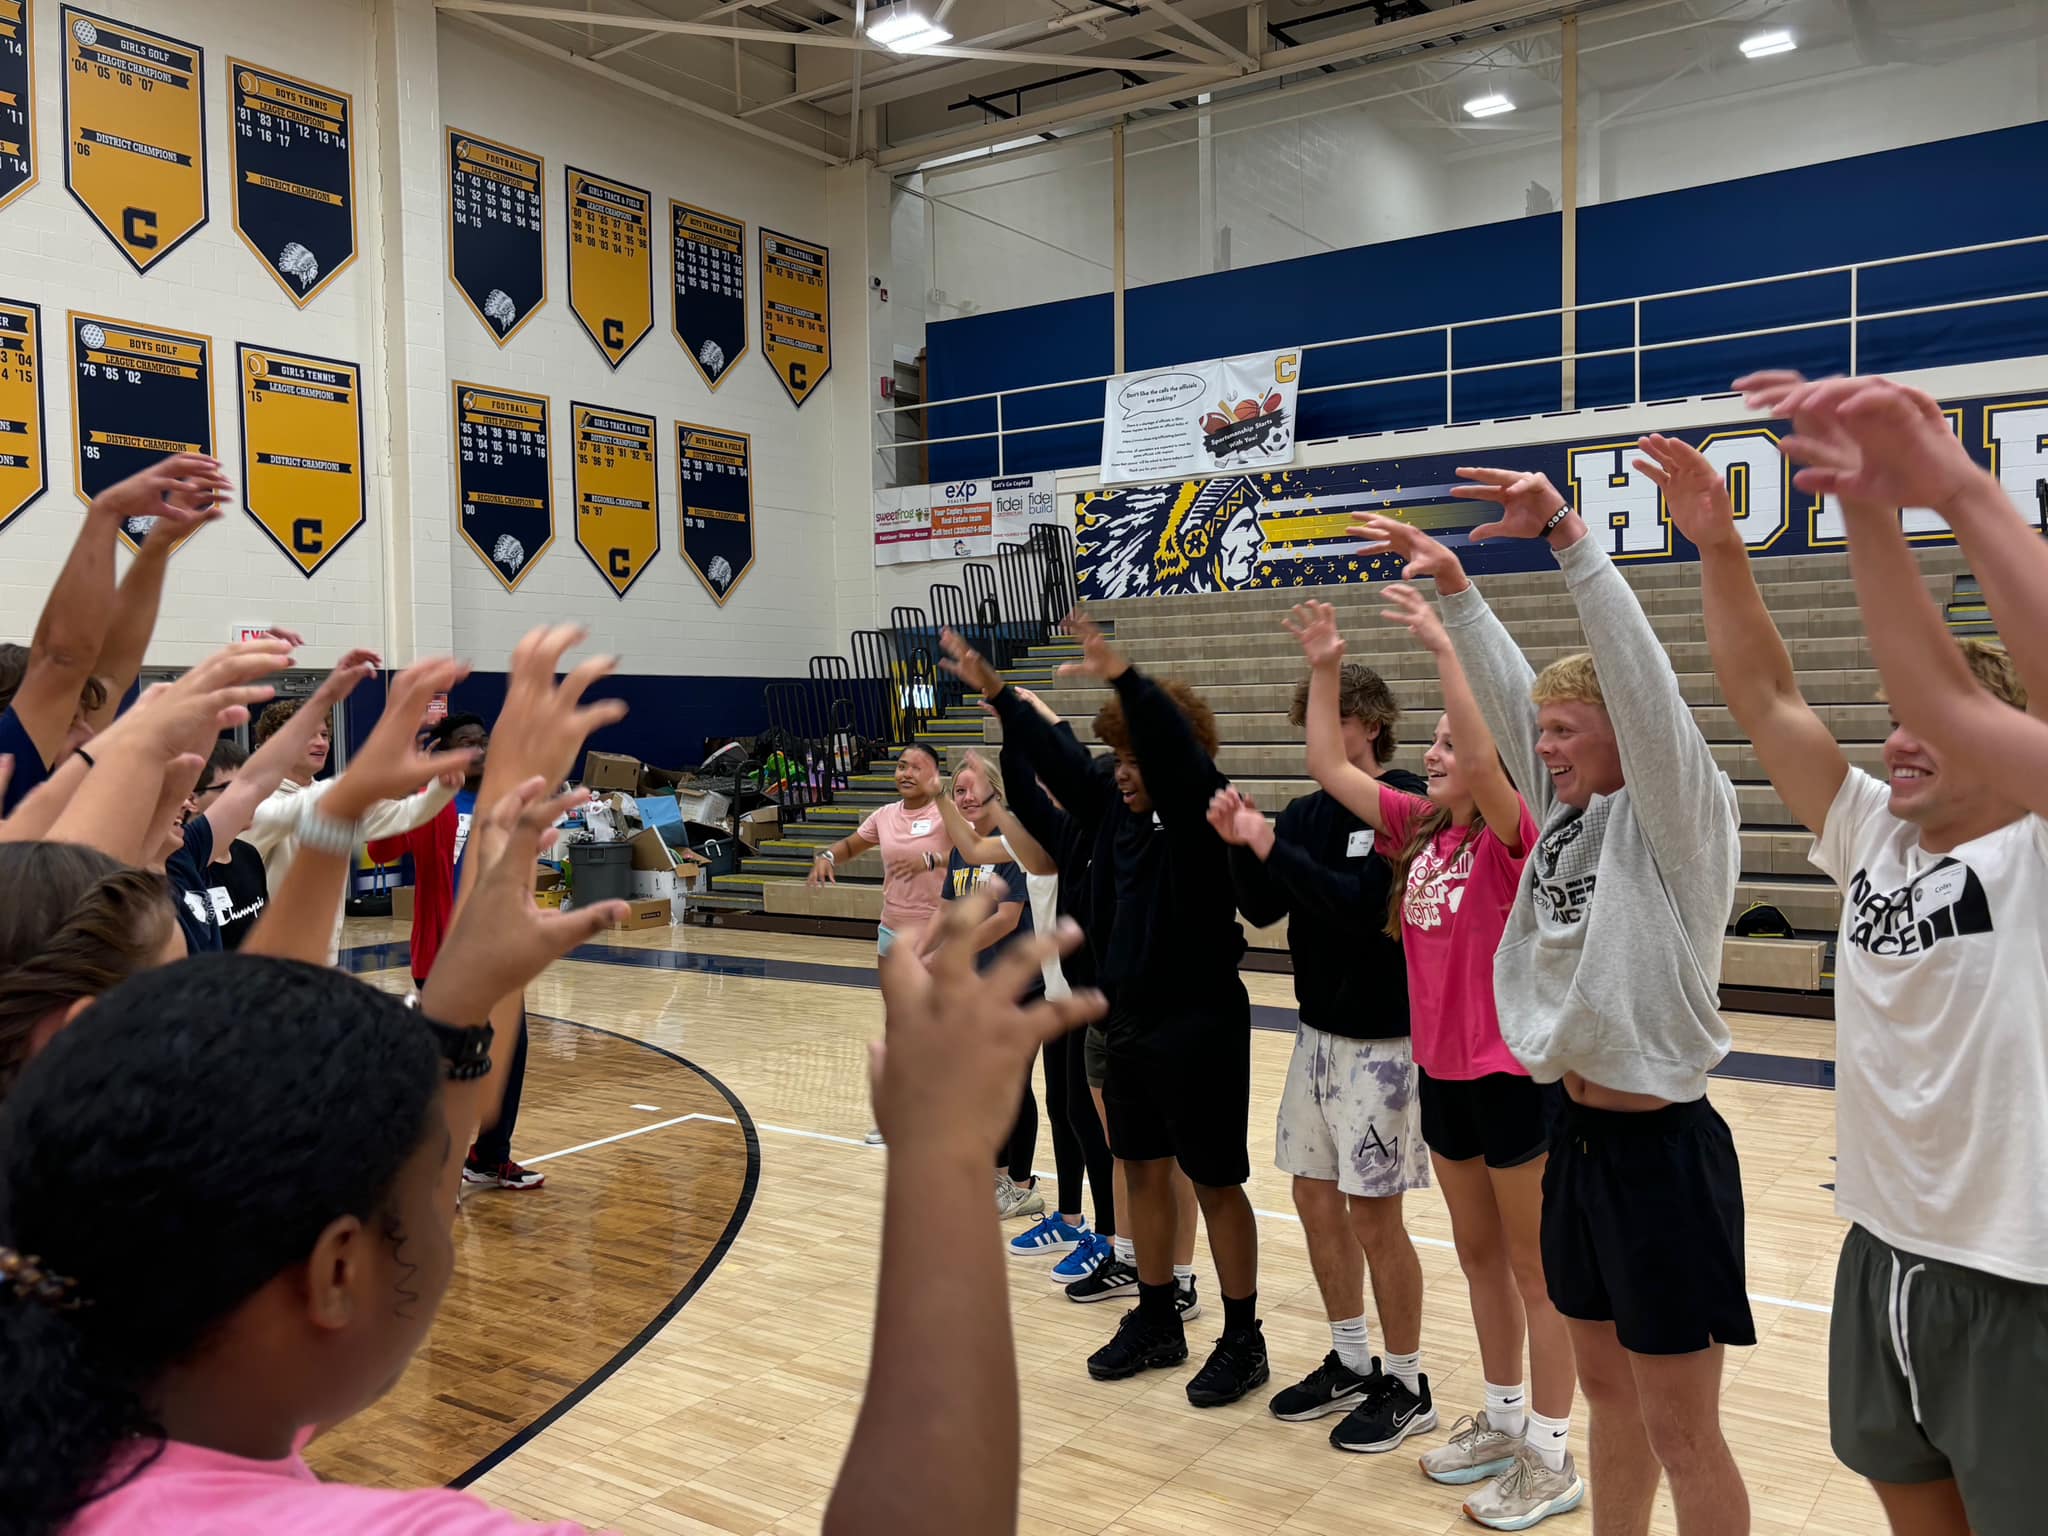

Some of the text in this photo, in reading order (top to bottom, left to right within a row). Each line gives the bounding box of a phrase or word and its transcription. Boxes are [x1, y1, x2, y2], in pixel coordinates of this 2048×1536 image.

[4, 39, 23, 56] '14
[120, 40, 170, 63] GIRLS GOLF
[71, 57, 154, 92] '04 '05 '06 '07
[96, 52, 172, 83] LEAGUE CHAMPIONS
[275, 87, 328, 112] BOYS TENNIS
[7, 109, 24, 126] '11
[260, 102, 325, 129] LEAGUE CHAMPIONS
[237, 106, 346, 150] '81 '83 '11 '12 '13 '14
[237, 122, 290, 147] '15 '16 '17
[73, 141, 91, 157] '06
[96, 132, 178, 162] DISTRICT CHAMPIONS
[9, 157, 28, 174] '14
[486, 153, 523, 172] FOOTBALL
[471, 165, 523, 187] LEAGUE CHAMPIONS
[260, 176, 330, 202] DISTRICT CHAMPIONS
[604, 190, 621, 203] TRACK
[122, 206, 158, 250] C
[603, 318, 624, 350] C
[130, 339, 178, 356] BOYS GOLF
[15, 352, 33, 367] '04
[105, 355, 181, 376] LEAGUE CHAMPIONS
[15, 368, 33, 383] '15
[79, 363, 142, 385] '76 '85 '02
[281, 366, 336, 383] GIRLS TENNIS
[789, 362, 807, 391] C
[1275, 354, 1296, 384] C
[248, 391, 263, 403] '15
[269, 382, 335, 400] LEAGUE CHAMPIONS
[1127, 391, 1139, 399] Don't
[1179, 381, 1197, 390] officials
[1156, 394, 1177, 402] making?
[491, 400, 528, 414] FOOTBALL
[594, 418, 609, 427] GIRLS
[610, 421, 627, 431] TRACK
[632, 425, 646, 435] FIELD
[1211, 419, 1273, 445] Sportsmanship Starts
[106, 434, 187, 452] DISTRICT CHAMPIONS
[506, 443, 517, 454] '10
[520, 444, 531, 456] '15
[1229, 433, 1258, 448] with You!
[83, 446, 100, 460] '85
[270, 455, 340, 472] DISTRICT CHAMPIONS
[1012, 480, 1030, 488] Copley!
[996, 496, 1023, 513] fidei
[1028, 490, 1053, 505] fidei
[1029, 504, 1053, 515] build
[293, 518, 323, 554] C
[609, 548, 630, 578] C
